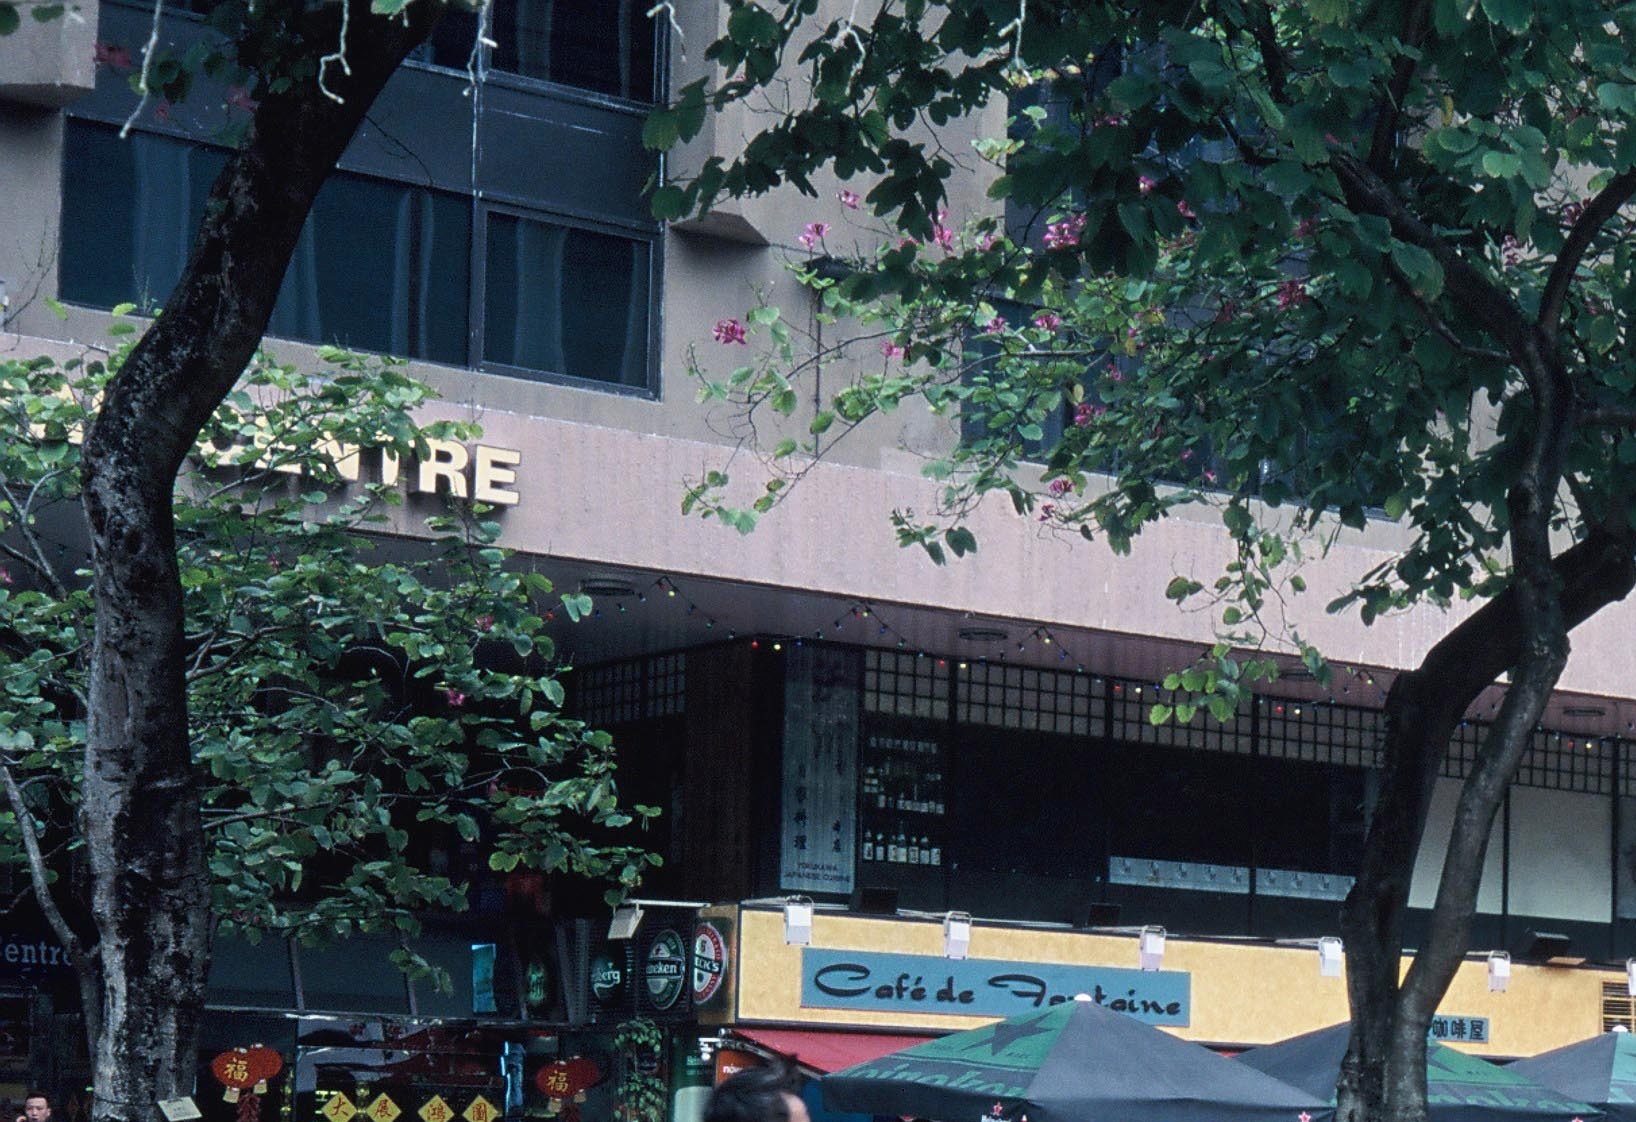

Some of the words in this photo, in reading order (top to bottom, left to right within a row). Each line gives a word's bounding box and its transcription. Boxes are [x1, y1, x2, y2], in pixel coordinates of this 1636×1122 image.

[814, 963, 928, 1002] Café
[936, 975, 976, 1005] de
[988, 973, 1183, 1016] Fotaine
[223, 1056, 250, 1083] 福
[545, 1069, 569, 1092] 福
